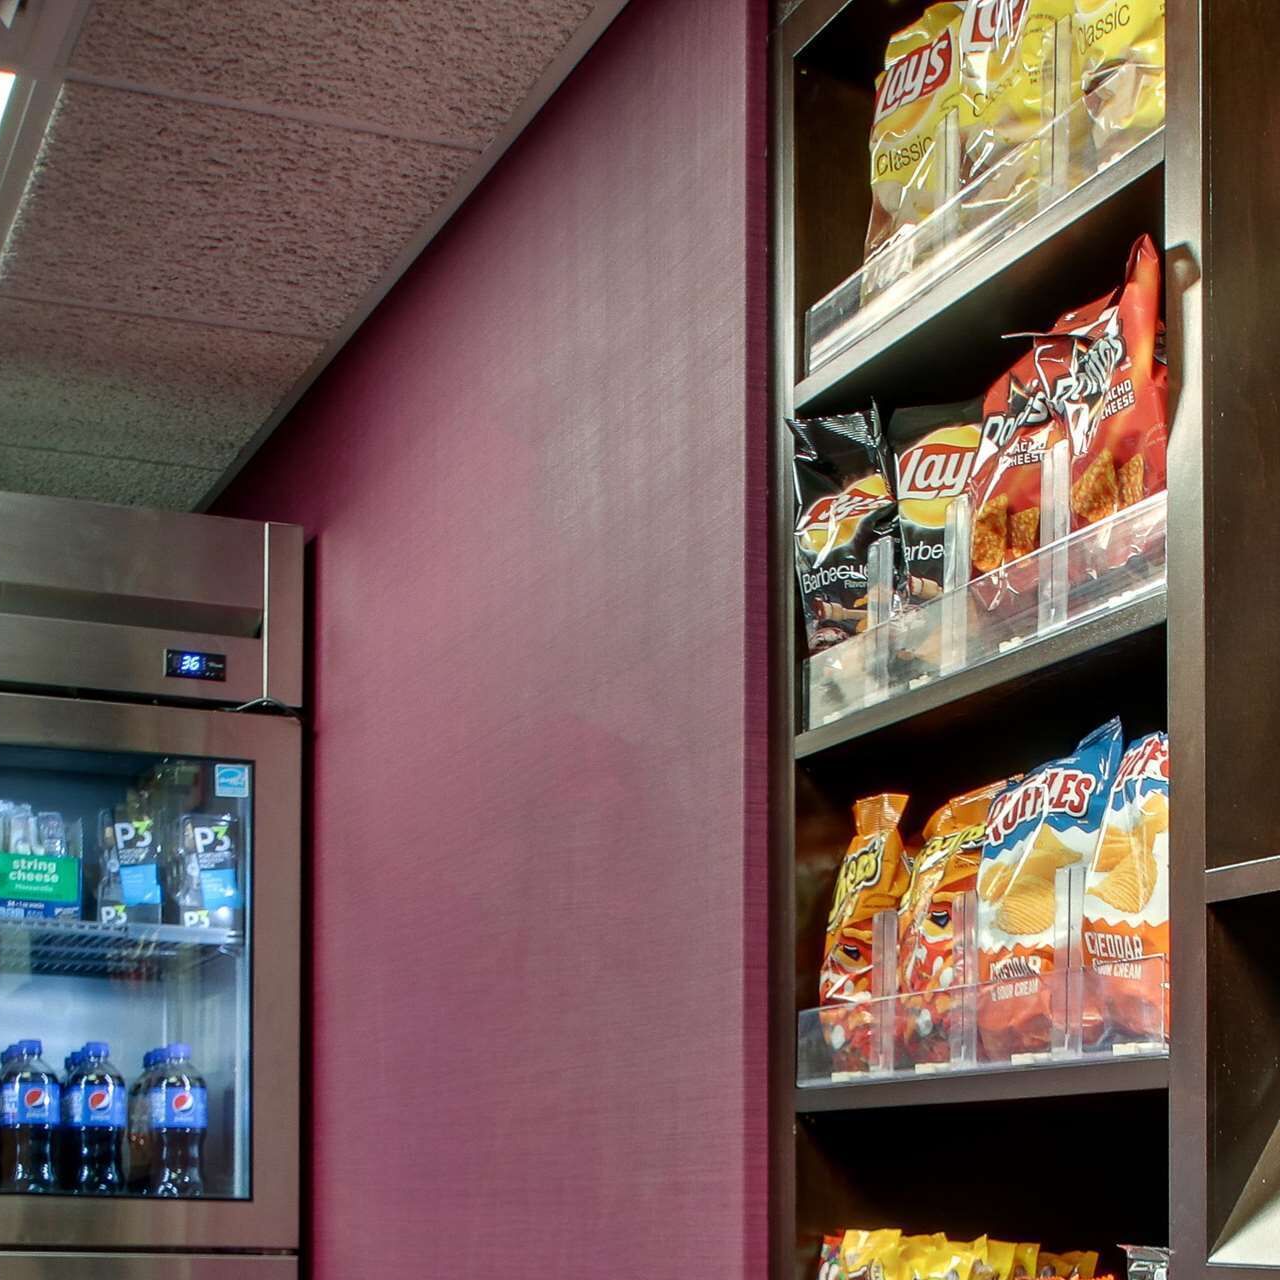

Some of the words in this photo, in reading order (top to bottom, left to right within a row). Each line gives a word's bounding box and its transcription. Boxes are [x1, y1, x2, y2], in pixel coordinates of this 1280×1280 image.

[875, 134, 934, 177] Classic
[181, 655, 200, 671] 36
[985, 767, 1097, 846] RUFFLES
[114, 817, 153, 849] P3
[194, 825, 231, 854] P3
[9, 871, 59, 884] cheese
[12, 859, 57, 875] string
[101, 904, 127, 926] P3
[183, 910, 210, 929] P3
